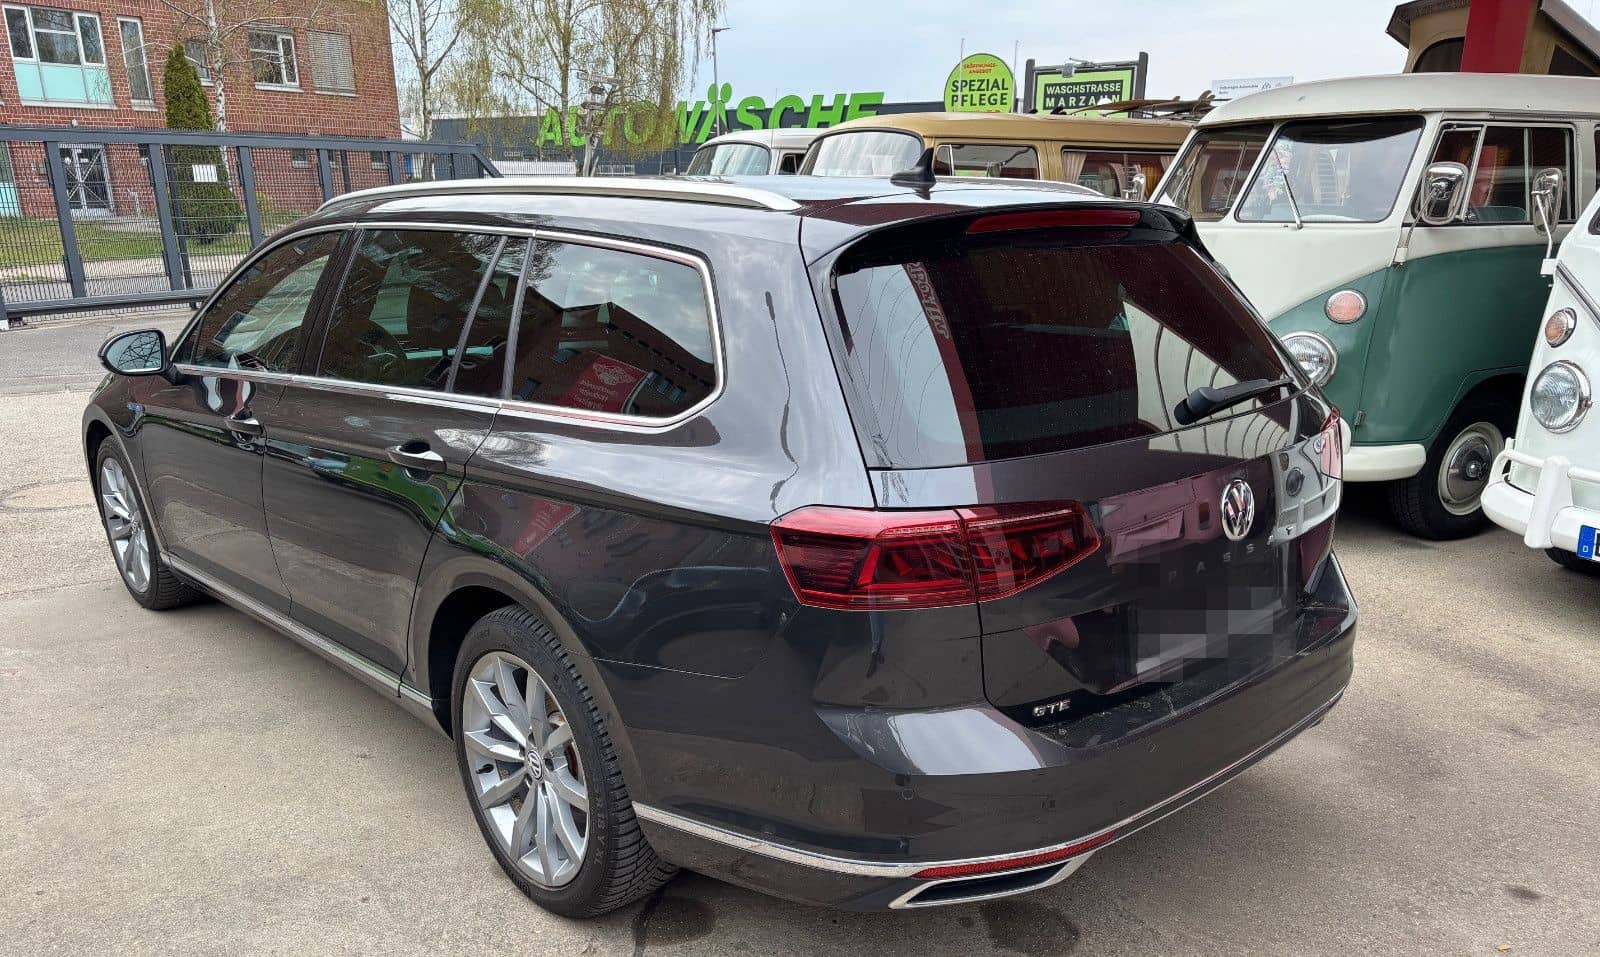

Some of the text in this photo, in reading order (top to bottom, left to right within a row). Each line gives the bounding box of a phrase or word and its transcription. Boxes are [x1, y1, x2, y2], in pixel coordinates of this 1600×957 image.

[951, 78, 1008, 92] SPEZIAL
[1046, 83, 1121, 95] WASCHSTRASSE
[951, 93, 1008, 107] PFLEGE
[1032, 699, 1070, 717] GTE
